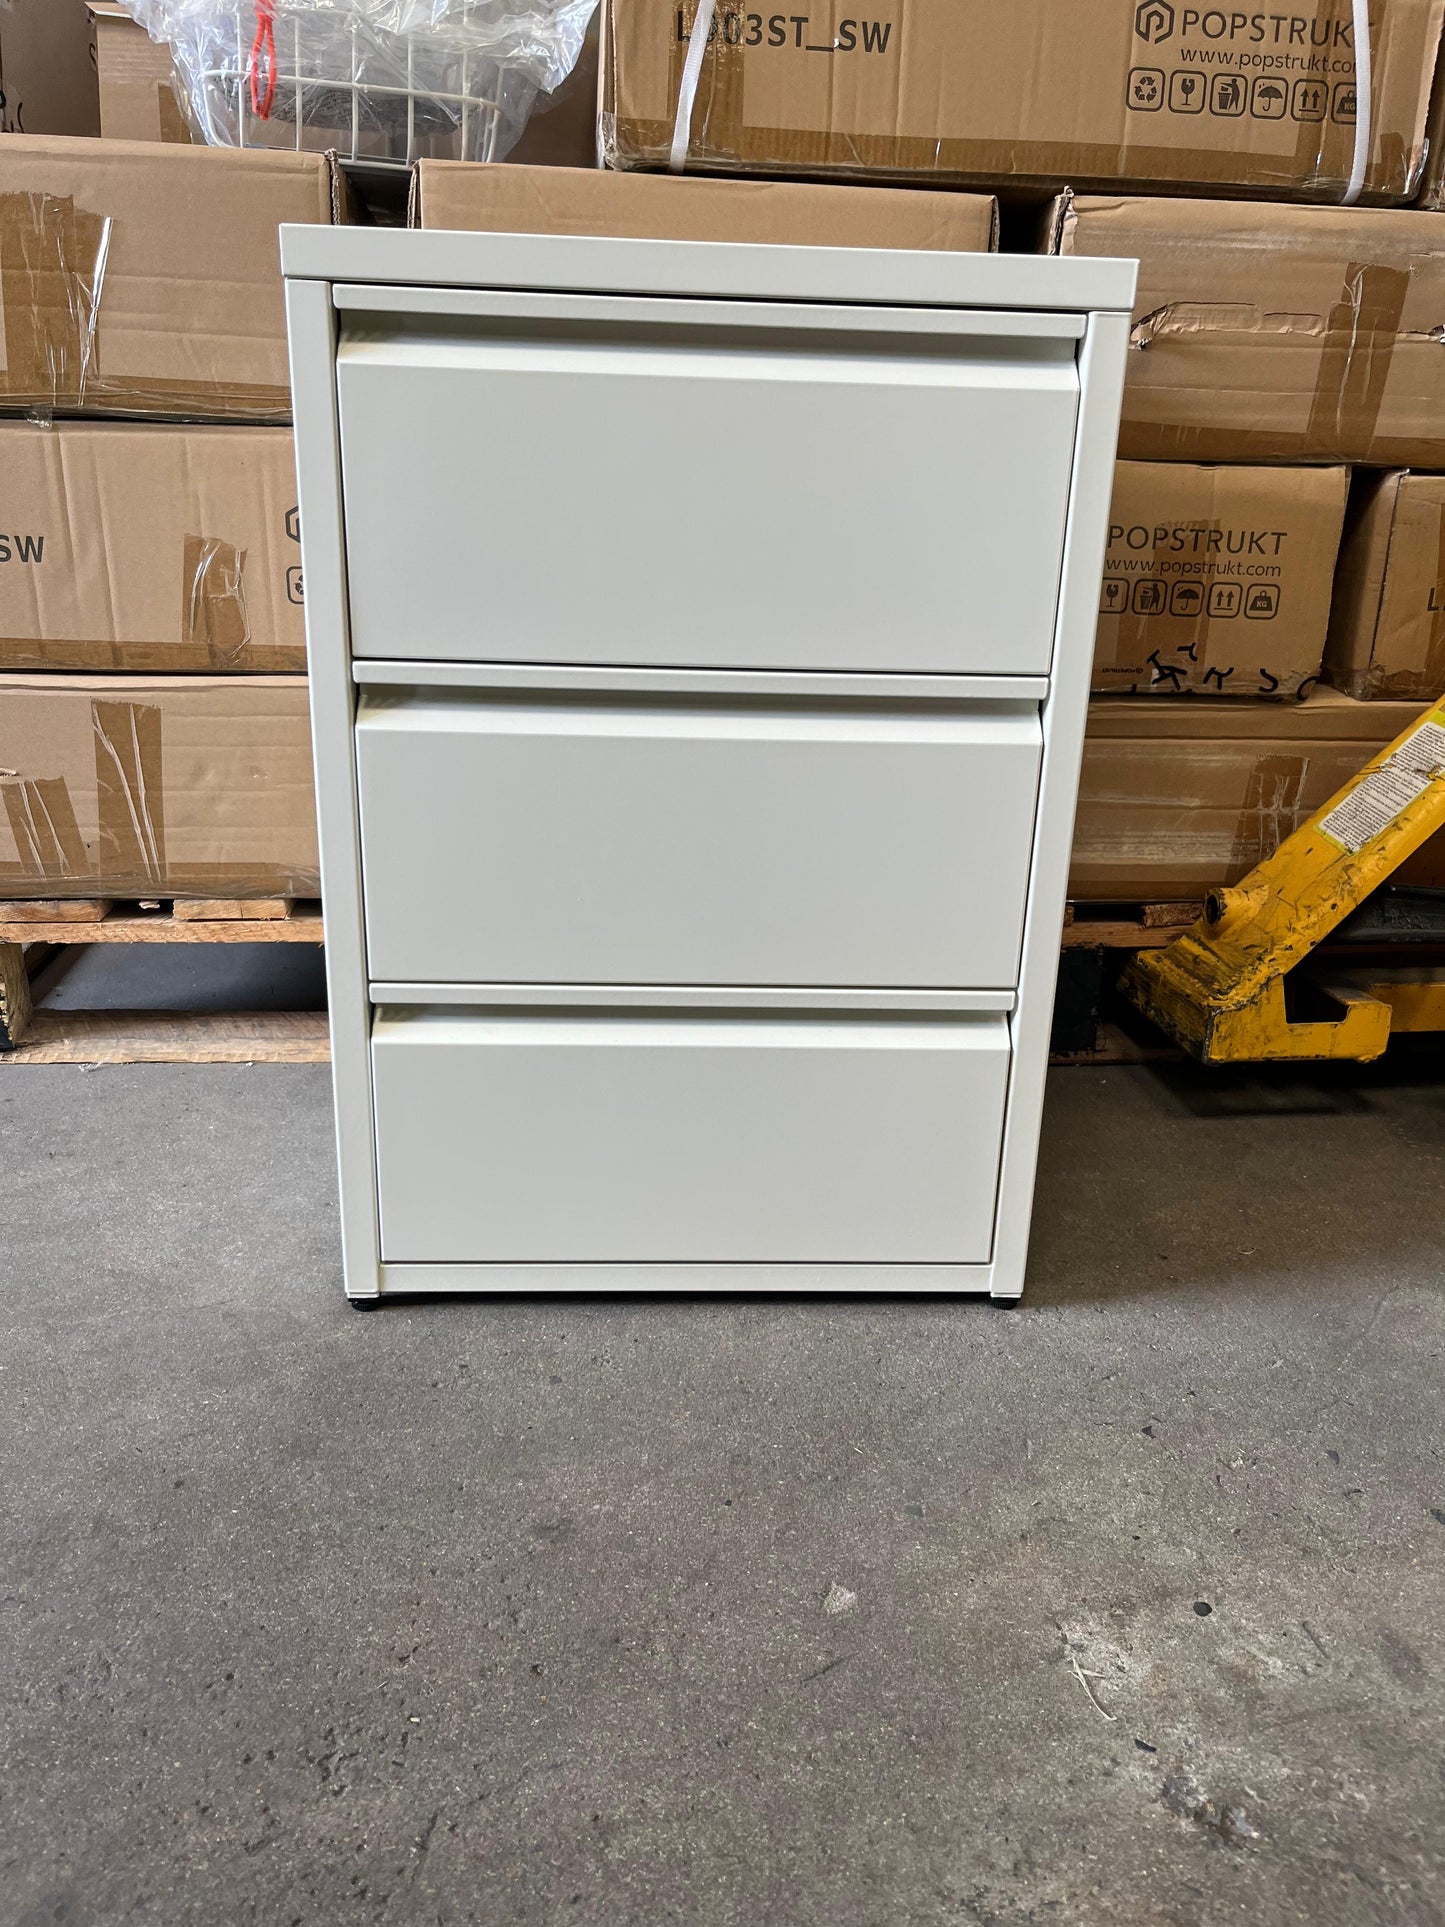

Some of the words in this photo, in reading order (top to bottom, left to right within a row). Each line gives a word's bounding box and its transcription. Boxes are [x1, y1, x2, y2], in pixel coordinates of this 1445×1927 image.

[1181, 9, 1375, 48] POPSTRUK
[1180, 48, 1357, 74] www.popstrukt.co
[1107, 524, 1288, 556] POPSTRUKT
[1106, 559, 1282, 577] www.popstrukt.com
